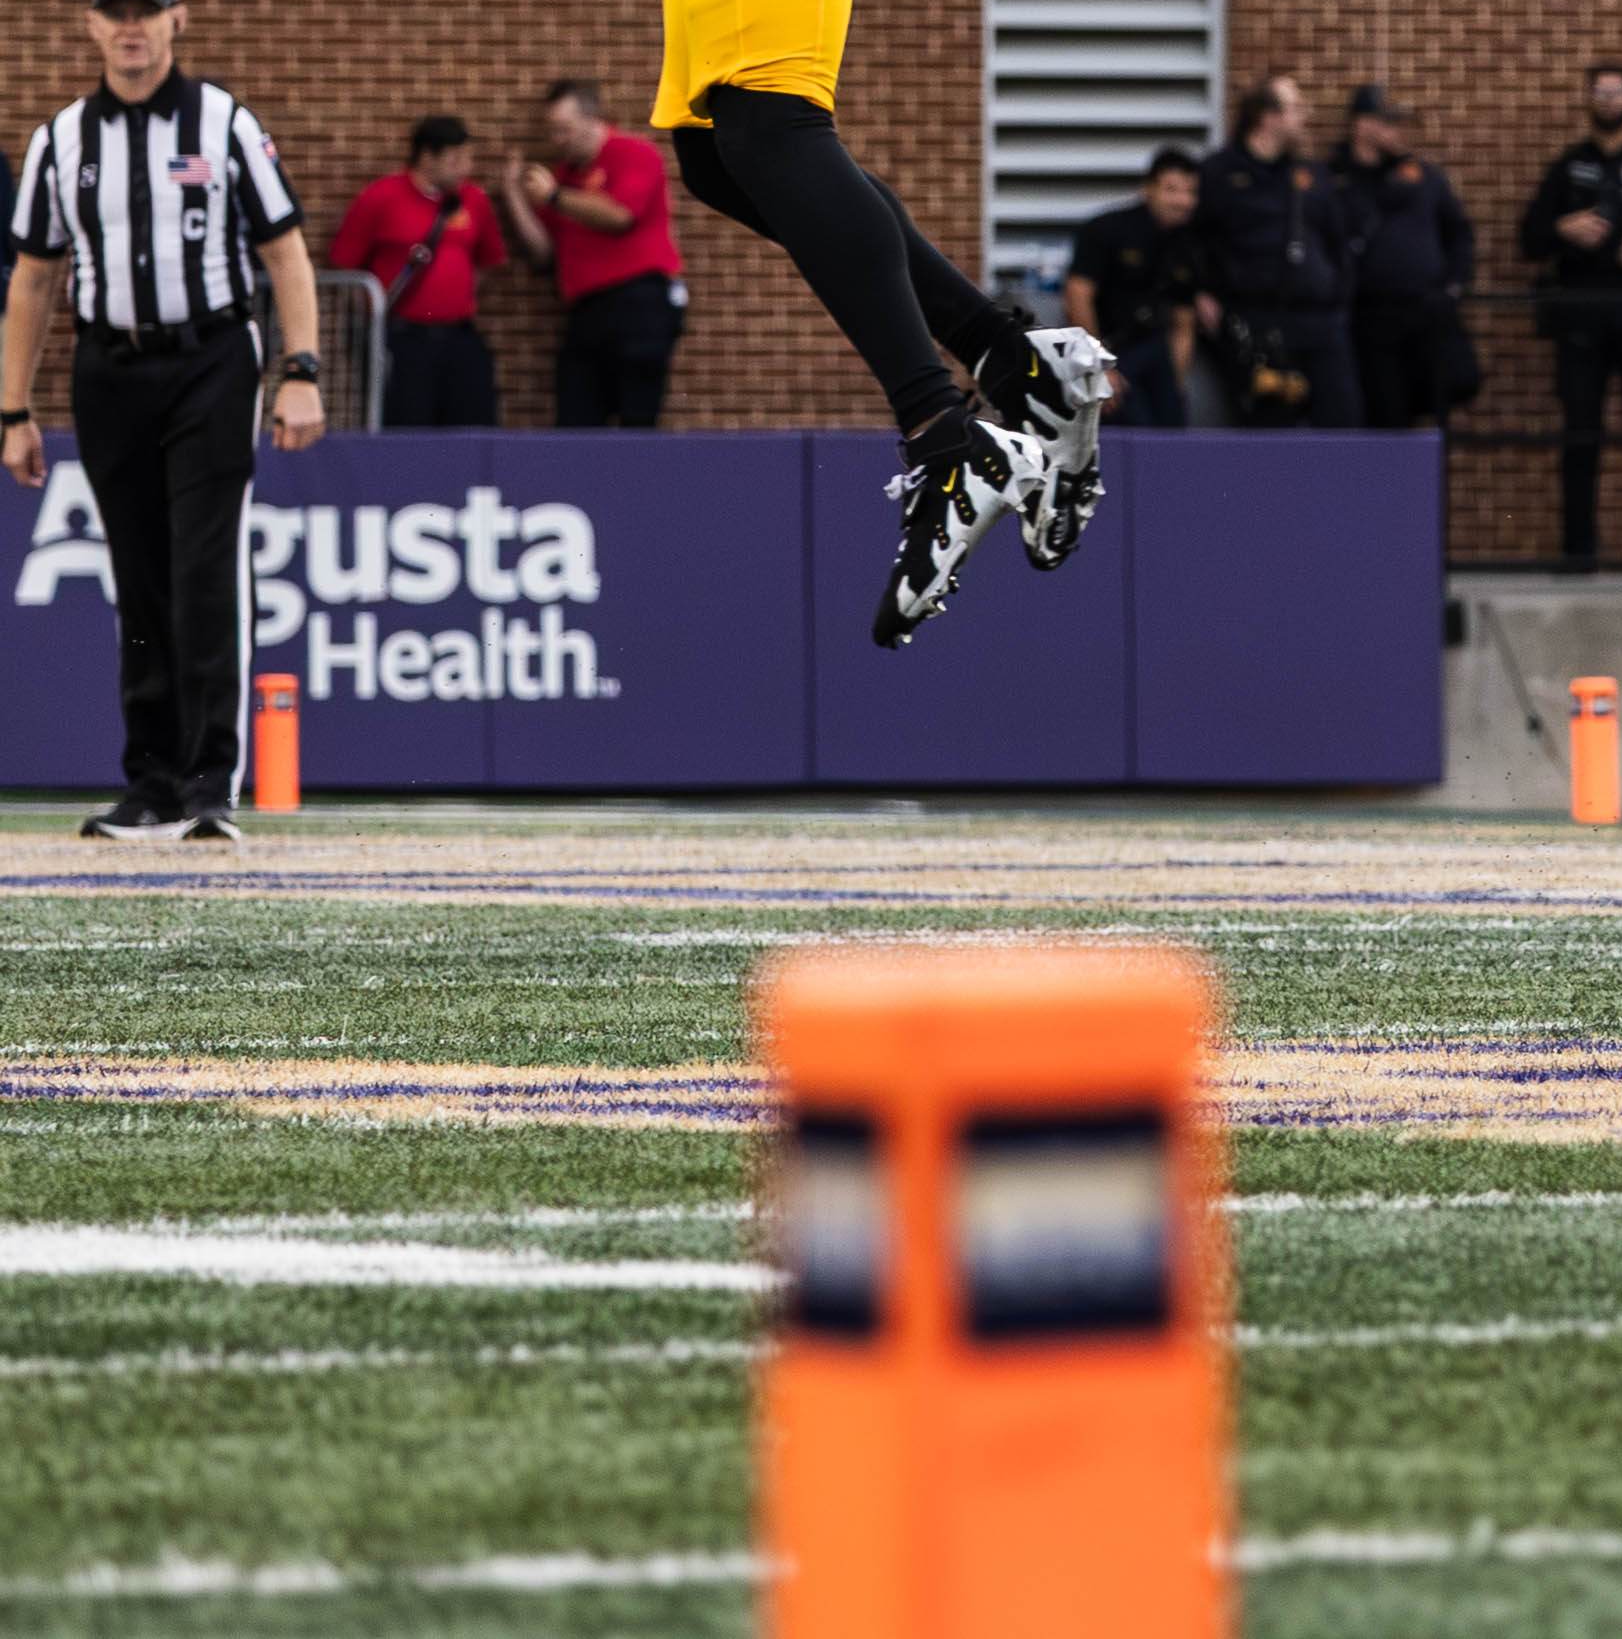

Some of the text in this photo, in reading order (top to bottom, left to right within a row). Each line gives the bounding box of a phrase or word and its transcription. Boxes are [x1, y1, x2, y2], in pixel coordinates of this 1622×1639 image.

[183, 208, 207, 241] C
[15, 460, 600, 647] Agusta
[307, 605, 599, 701] Health
